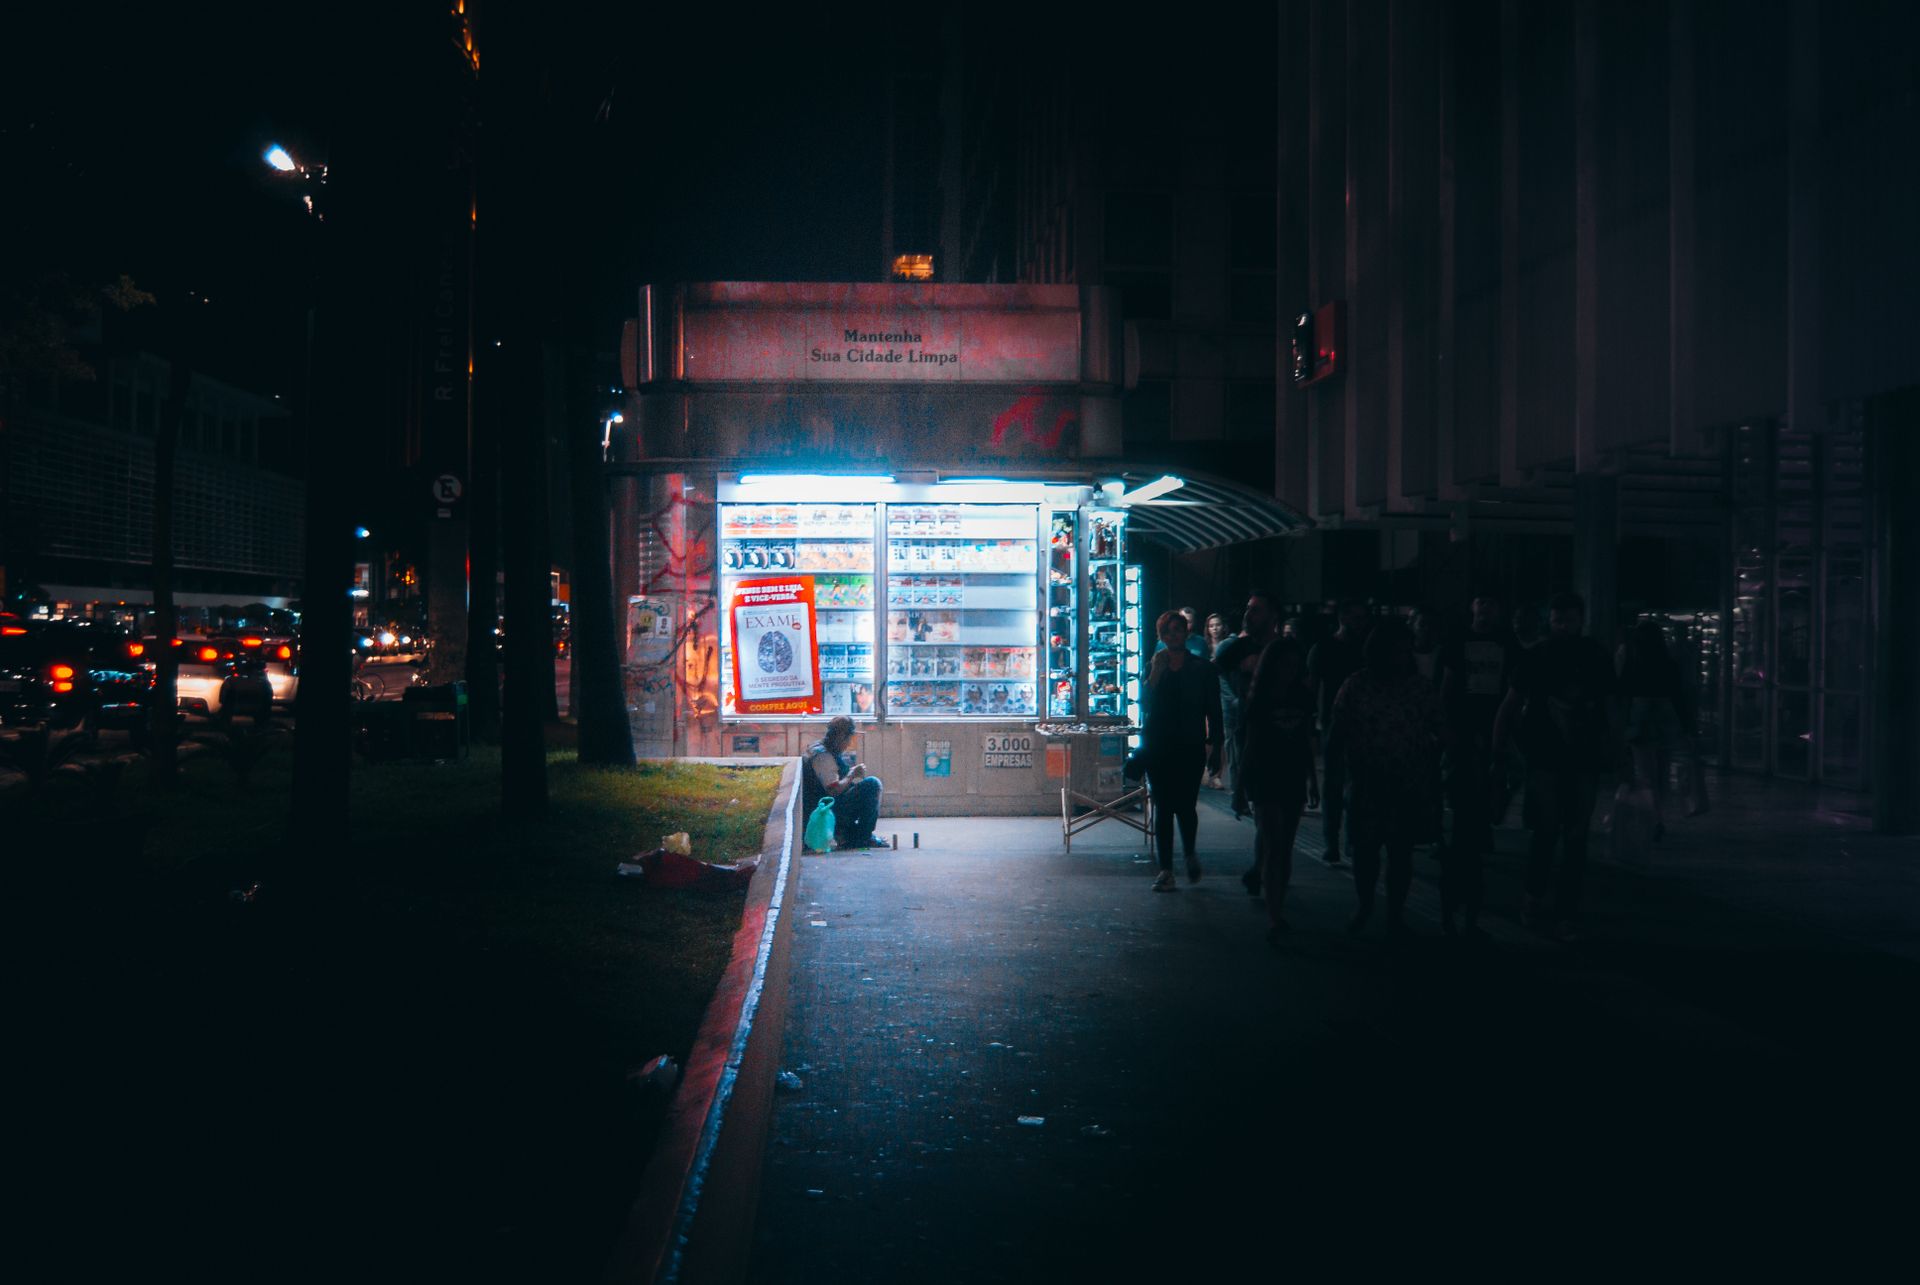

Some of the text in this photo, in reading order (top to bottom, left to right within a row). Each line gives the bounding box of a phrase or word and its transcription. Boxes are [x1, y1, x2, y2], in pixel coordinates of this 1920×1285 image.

[434, 230, 455, 318] Cane
[843, 329, 923, 343] Mantenha
[433, 327, 454, 373] Frei
[810, 348, 958, 366] Sua Cidade Limpa
[745, 614, 799, 629] EXAME
[749, 701, 808, 712] COMPRE AQUI
[987, 737, 1031, 751] 3.000
[985, 754, 1032, 767] EMPRESAS
